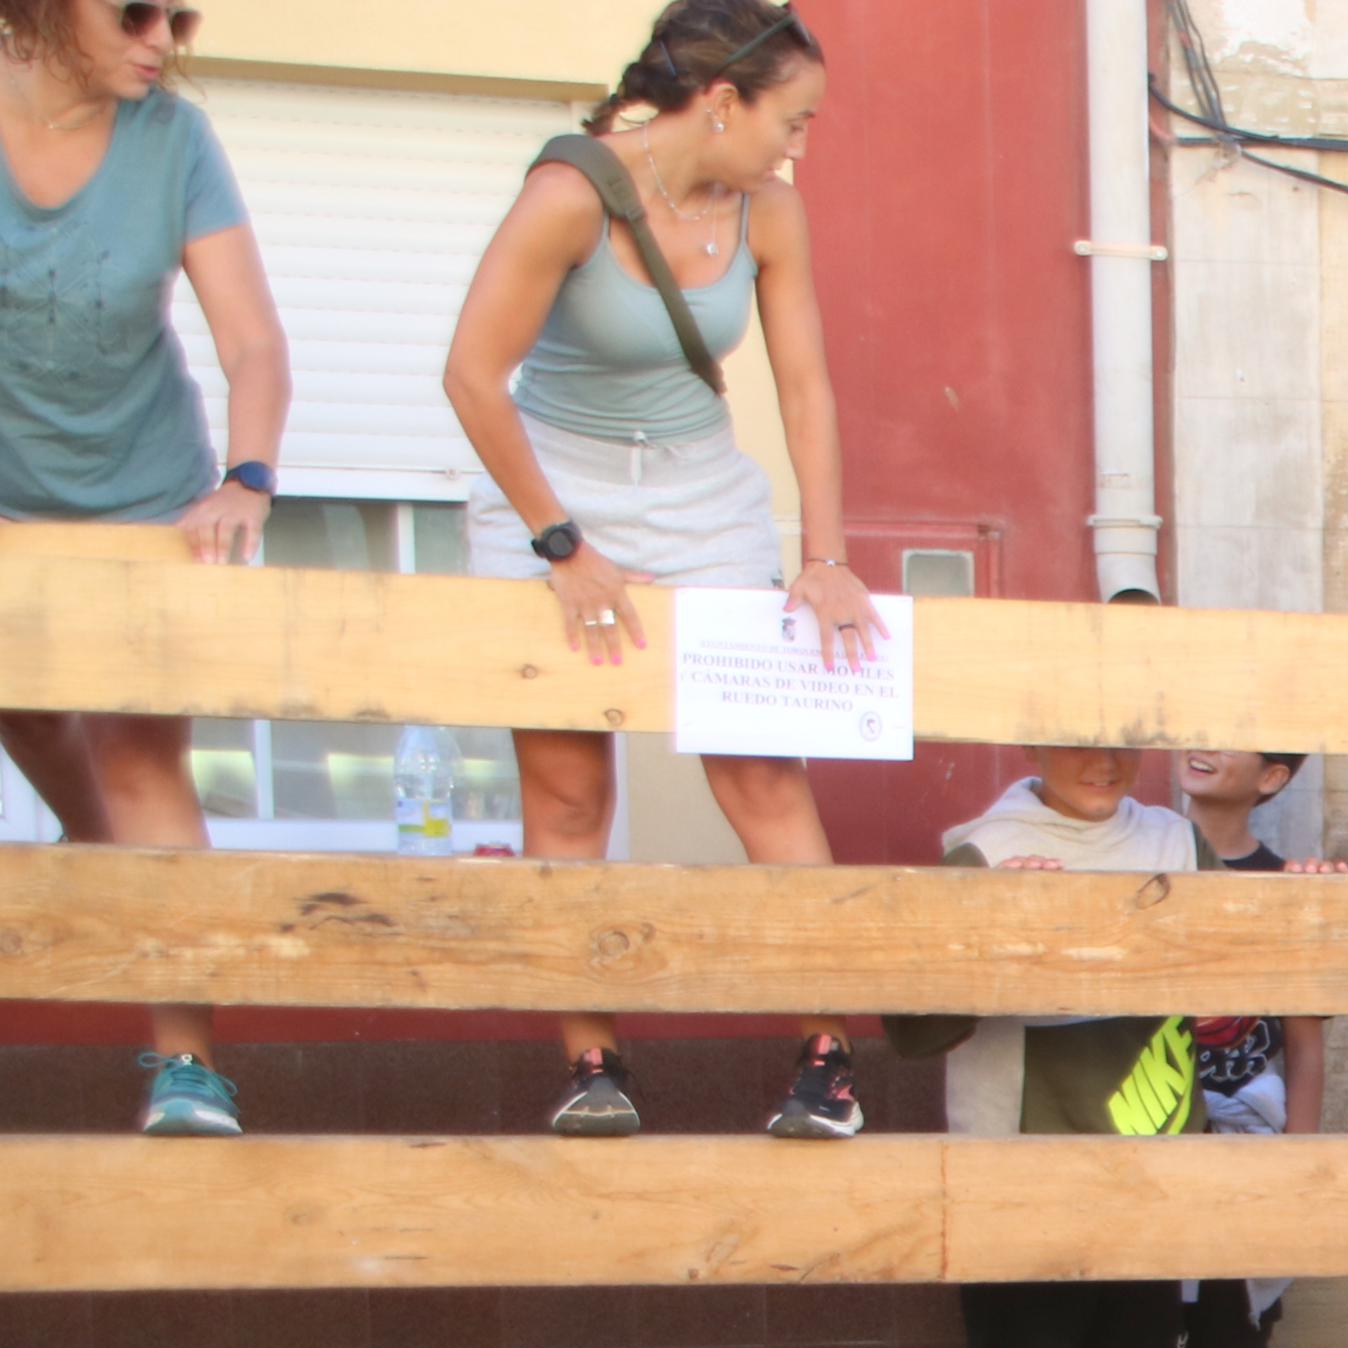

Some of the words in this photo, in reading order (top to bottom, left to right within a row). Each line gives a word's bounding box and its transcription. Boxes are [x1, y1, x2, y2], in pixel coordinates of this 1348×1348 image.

[682, 653, 774, 672] PROHIBIDO
[777, 659, 818, 675] USAR
[775, 677, 796, 690] DE
[853, 683, 874, 698] EN
[879, 685, 899, 699] EL
[721, 690, 778, 706] RUEDO
[782, 694, 855, 713] TAURINO
[1107, 1015, 1193, 1136] NIKE
